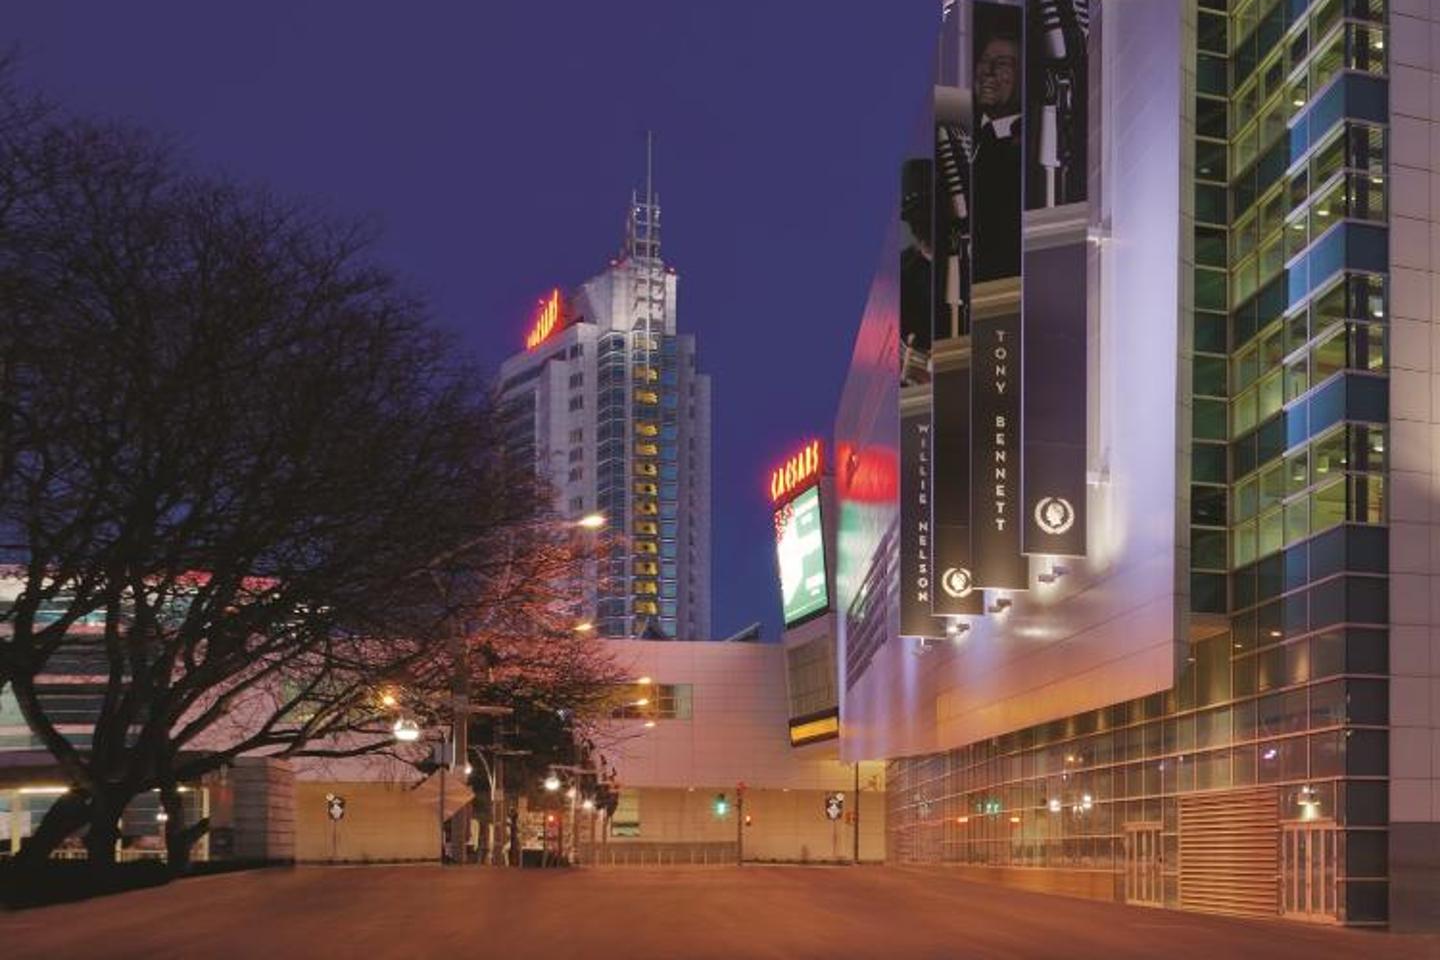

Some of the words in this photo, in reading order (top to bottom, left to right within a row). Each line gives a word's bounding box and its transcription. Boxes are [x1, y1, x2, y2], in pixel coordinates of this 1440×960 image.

[995, 330, 1008, 394] TONY
[771, 440, 819, 501] CAESARS
[917, 423, 930, 504] WILLIE
[995, 416, 1007, 531] BENNETT
[917, 522, 930, 602] NELSON
